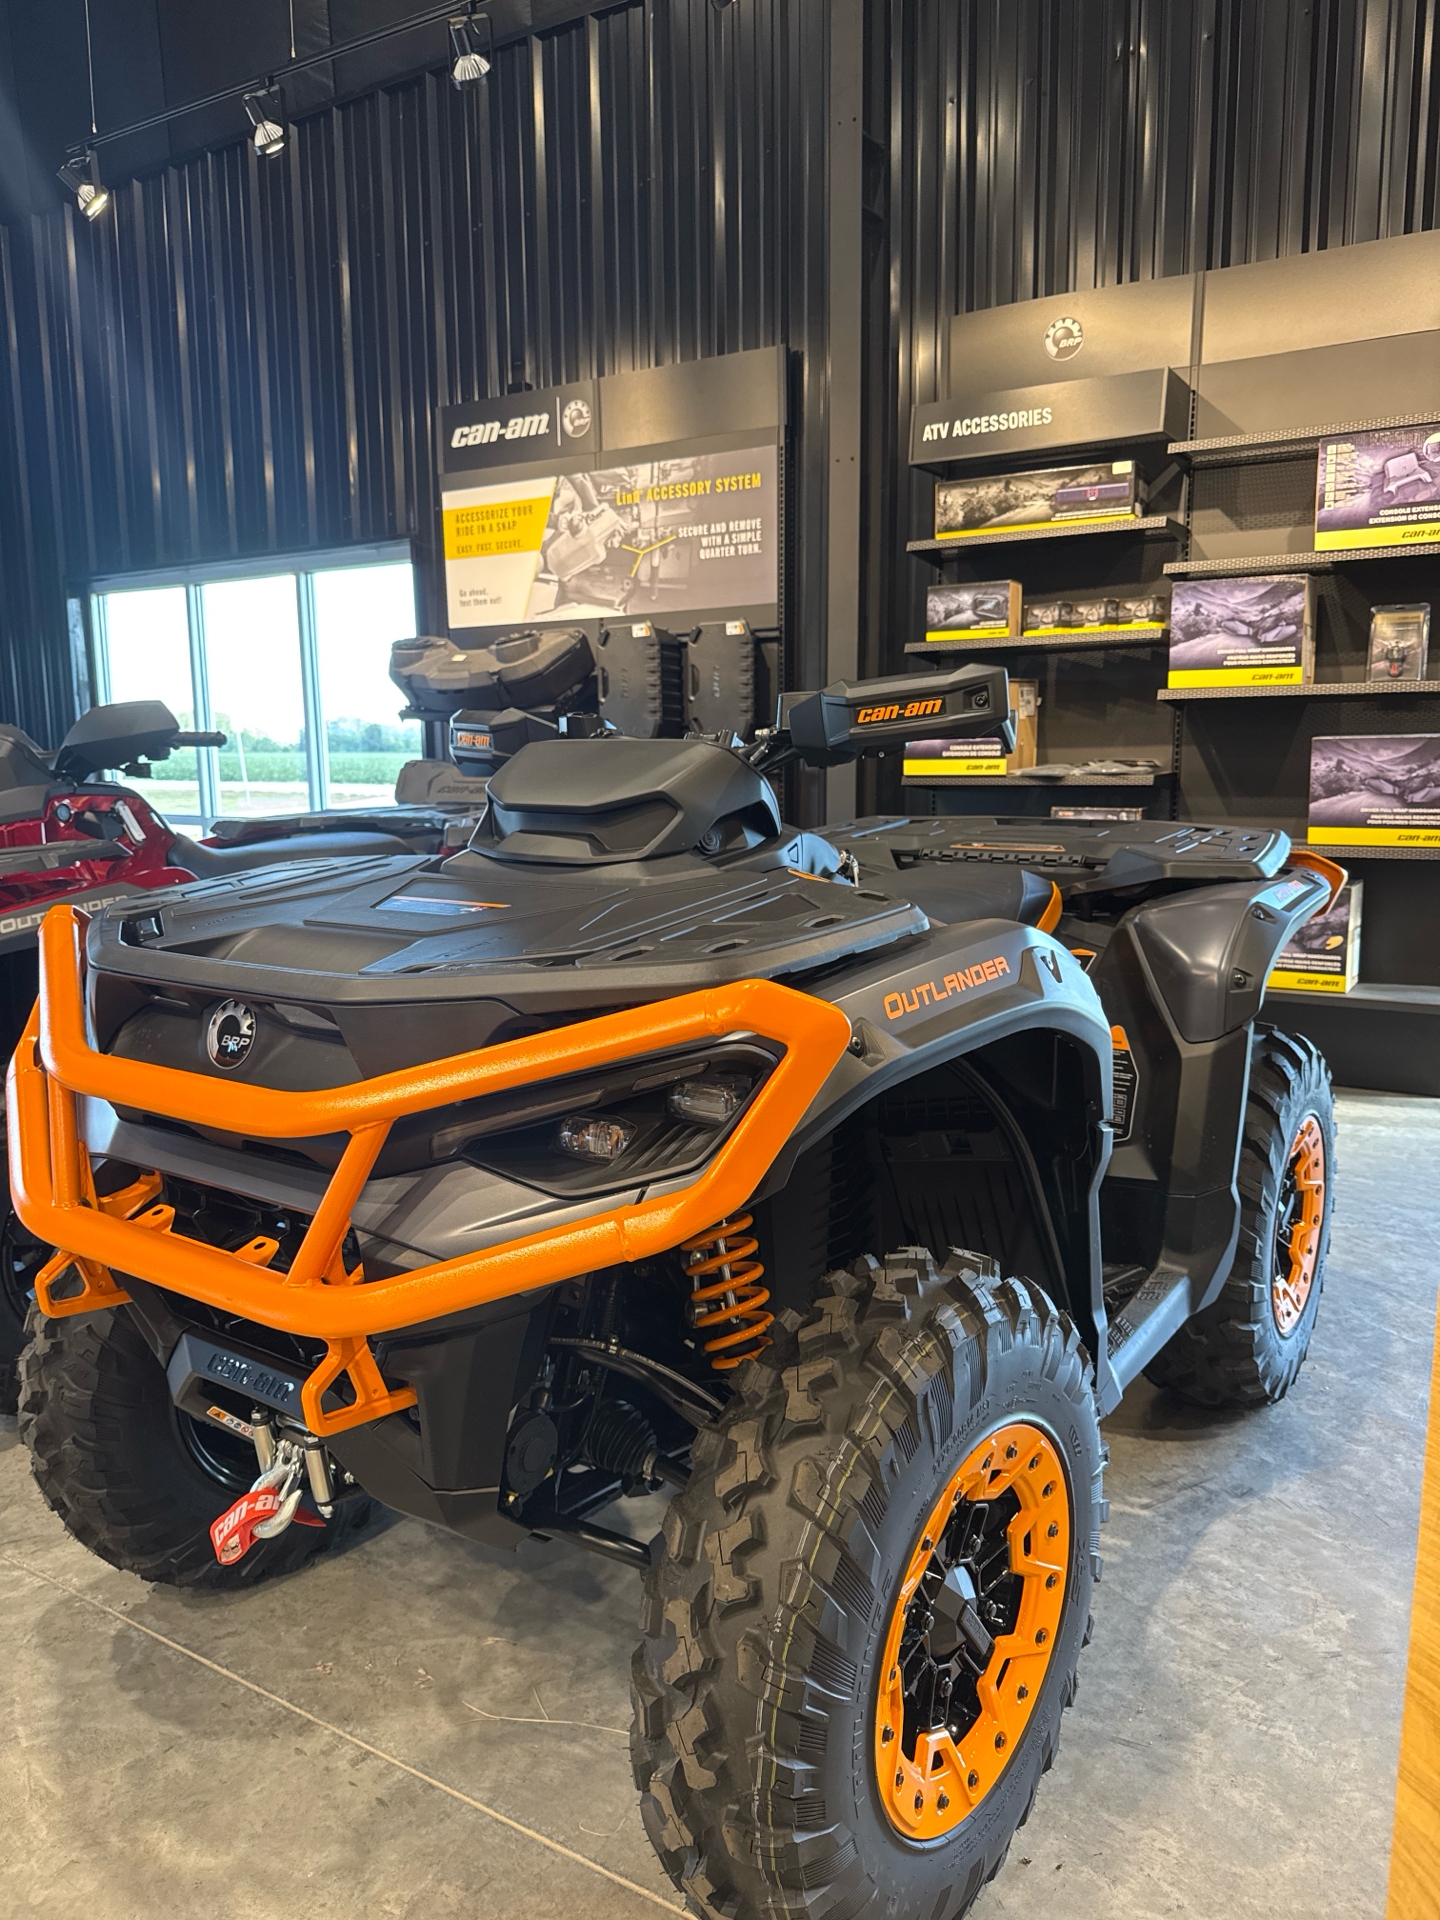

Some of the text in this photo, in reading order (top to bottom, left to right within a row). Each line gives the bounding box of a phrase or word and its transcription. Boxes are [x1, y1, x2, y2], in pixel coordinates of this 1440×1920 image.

[1058, 336, 1082, 349] BRP
[451, 413, 549, 448] can-am
[922, 407, 1053, 442] ATV ACCESSORIES
[646, 480, 711, 502] ACCESSORY
[715, 472, 761, 493] SYSTEM
[455, 505, 534, 525] ACCESSORIZE YOUR
[1379, 507, 1411, 516] CONSOLE
[456, 520, 517, 537] RIDE IN A SNAP
[677, 518, 761, 538] SECURE AND REMOVE
[1369, 516, 1407, 525] EXTENSION
[700, 531, 761, 547] WITH A SIMPLE
[700, 543, 762, 560] QUARTER TURN.
[1251, 673, 1294, 681] can-am
[857, 699, 942, 723] can-am
[457, 733, 490, 747] can-am
[883, 956, 1011, 1020] OUTLANDER
[1296, 978, 1340, 987] can-am
[220, 1034, 251, 1049] BRP
[206, 1353, 295, 1402] can-am
